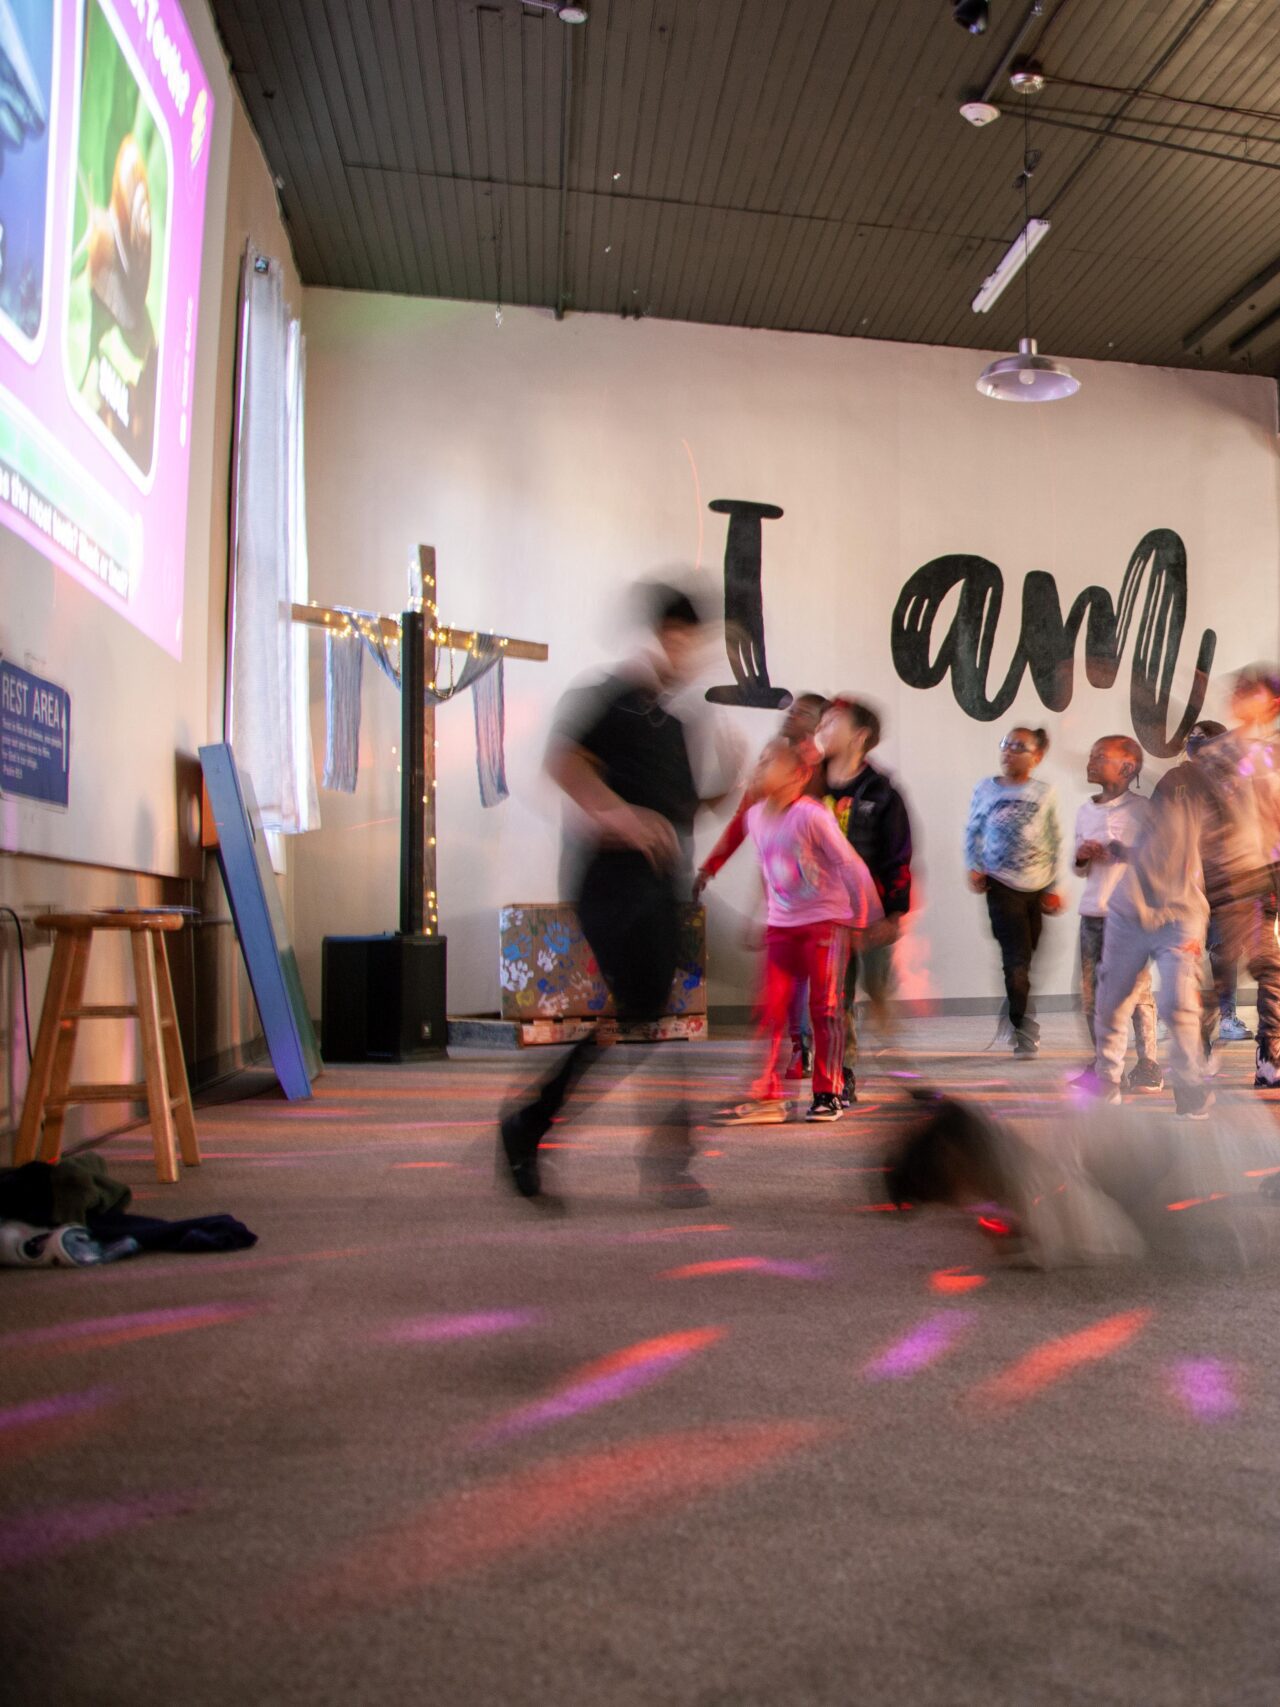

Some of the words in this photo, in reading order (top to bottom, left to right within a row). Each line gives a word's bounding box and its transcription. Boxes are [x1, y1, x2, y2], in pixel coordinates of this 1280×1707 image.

[2, 671, 28, 718] REST
[33, 685, 60, 730] AREA
[705, 499, 793, 709] I
[891, 528, 1217, 758] am
